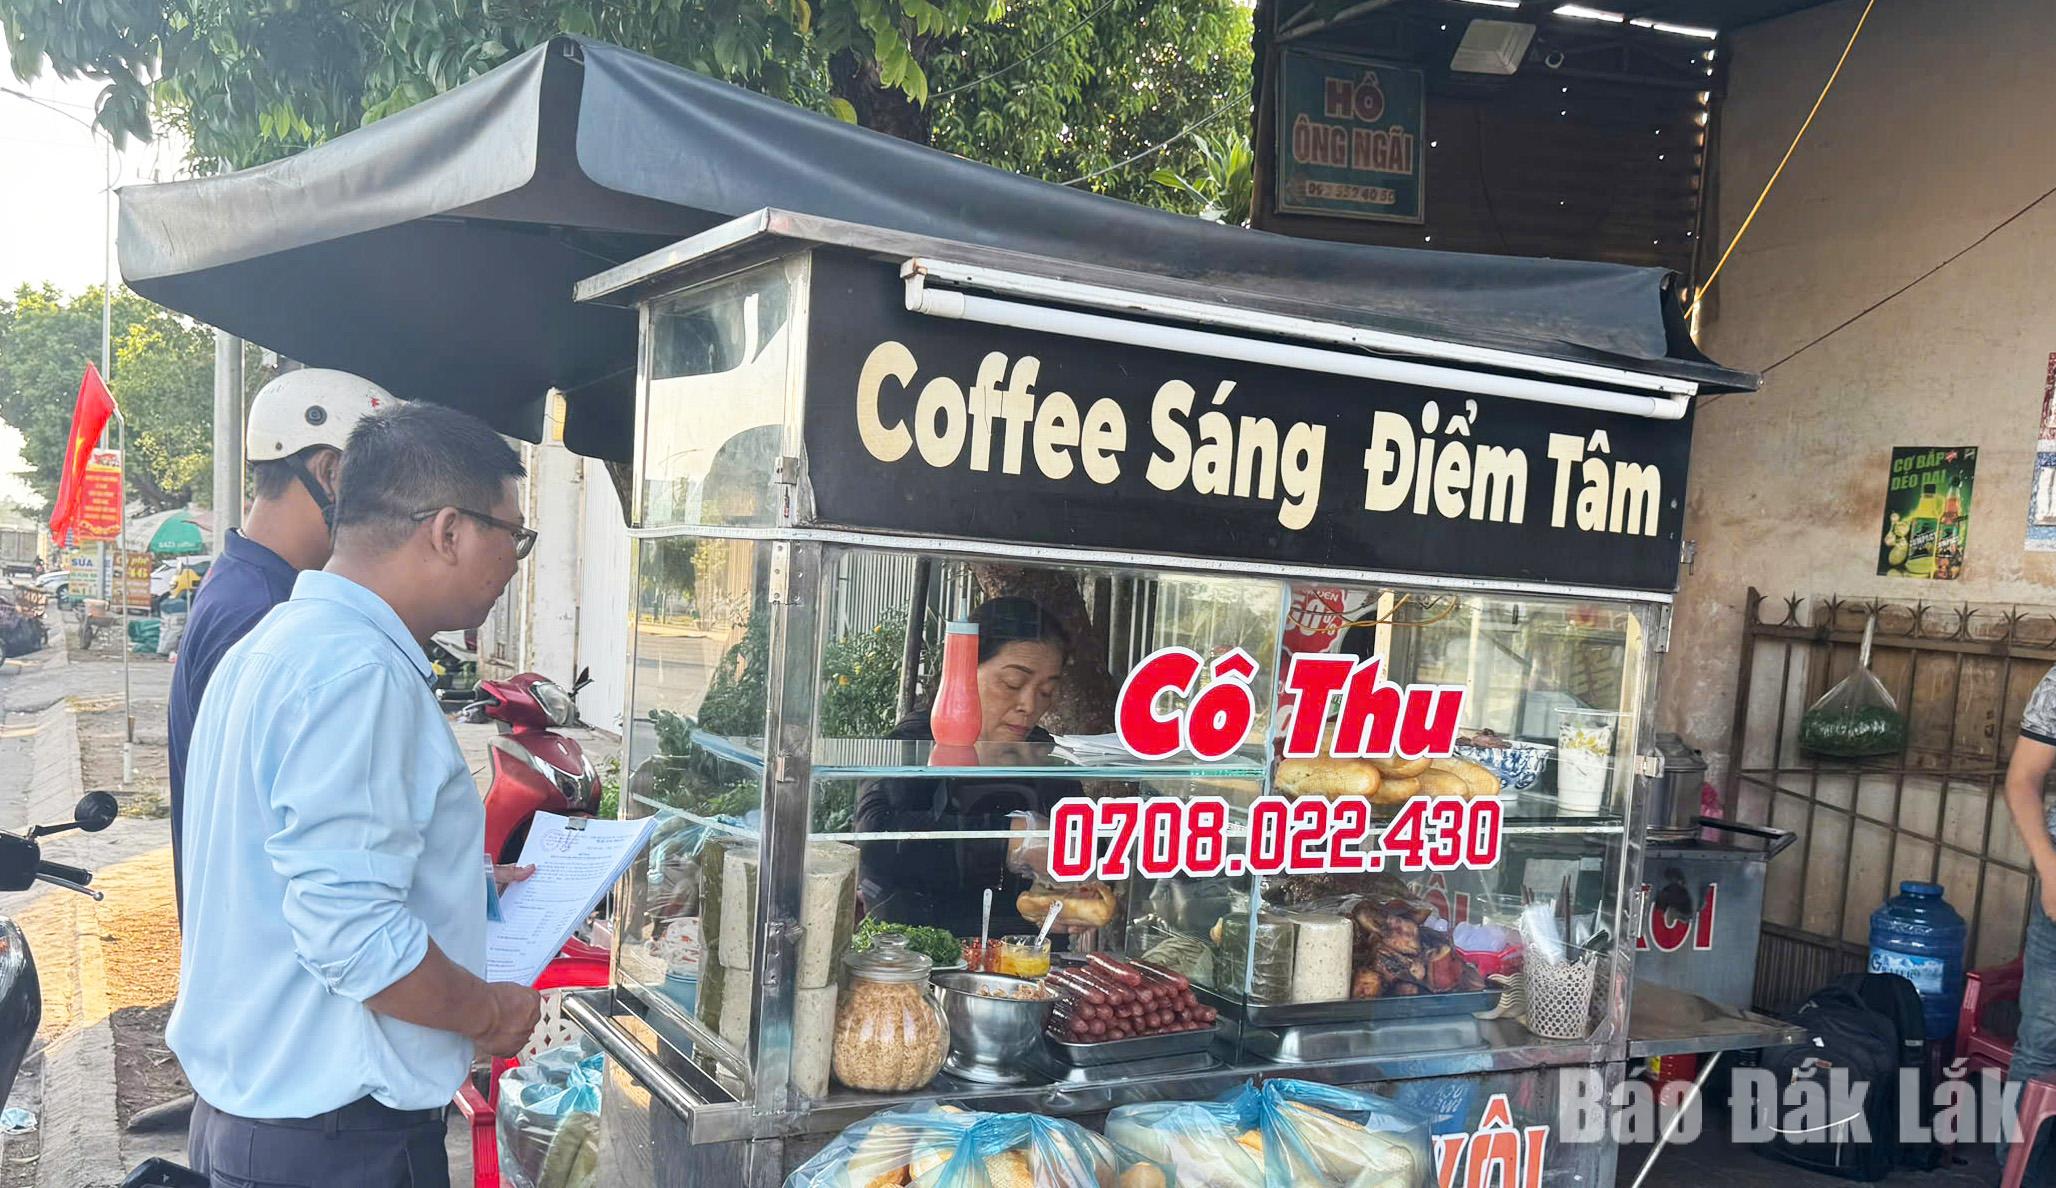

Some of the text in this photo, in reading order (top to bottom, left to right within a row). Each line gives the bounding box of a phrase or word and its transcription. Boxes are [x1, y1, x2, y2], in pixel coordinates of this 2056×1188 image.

[1292, 113, 1414, 175] ÔNG NGÃI
[857, 341, 1661, 536] Coffee Sáng Điểm Tâm
[1115, 646, 1260, 760] Cô
[1283, 652, 1468, 760] Thu
[1047, 795, 1504, 882] 0708.022.430
